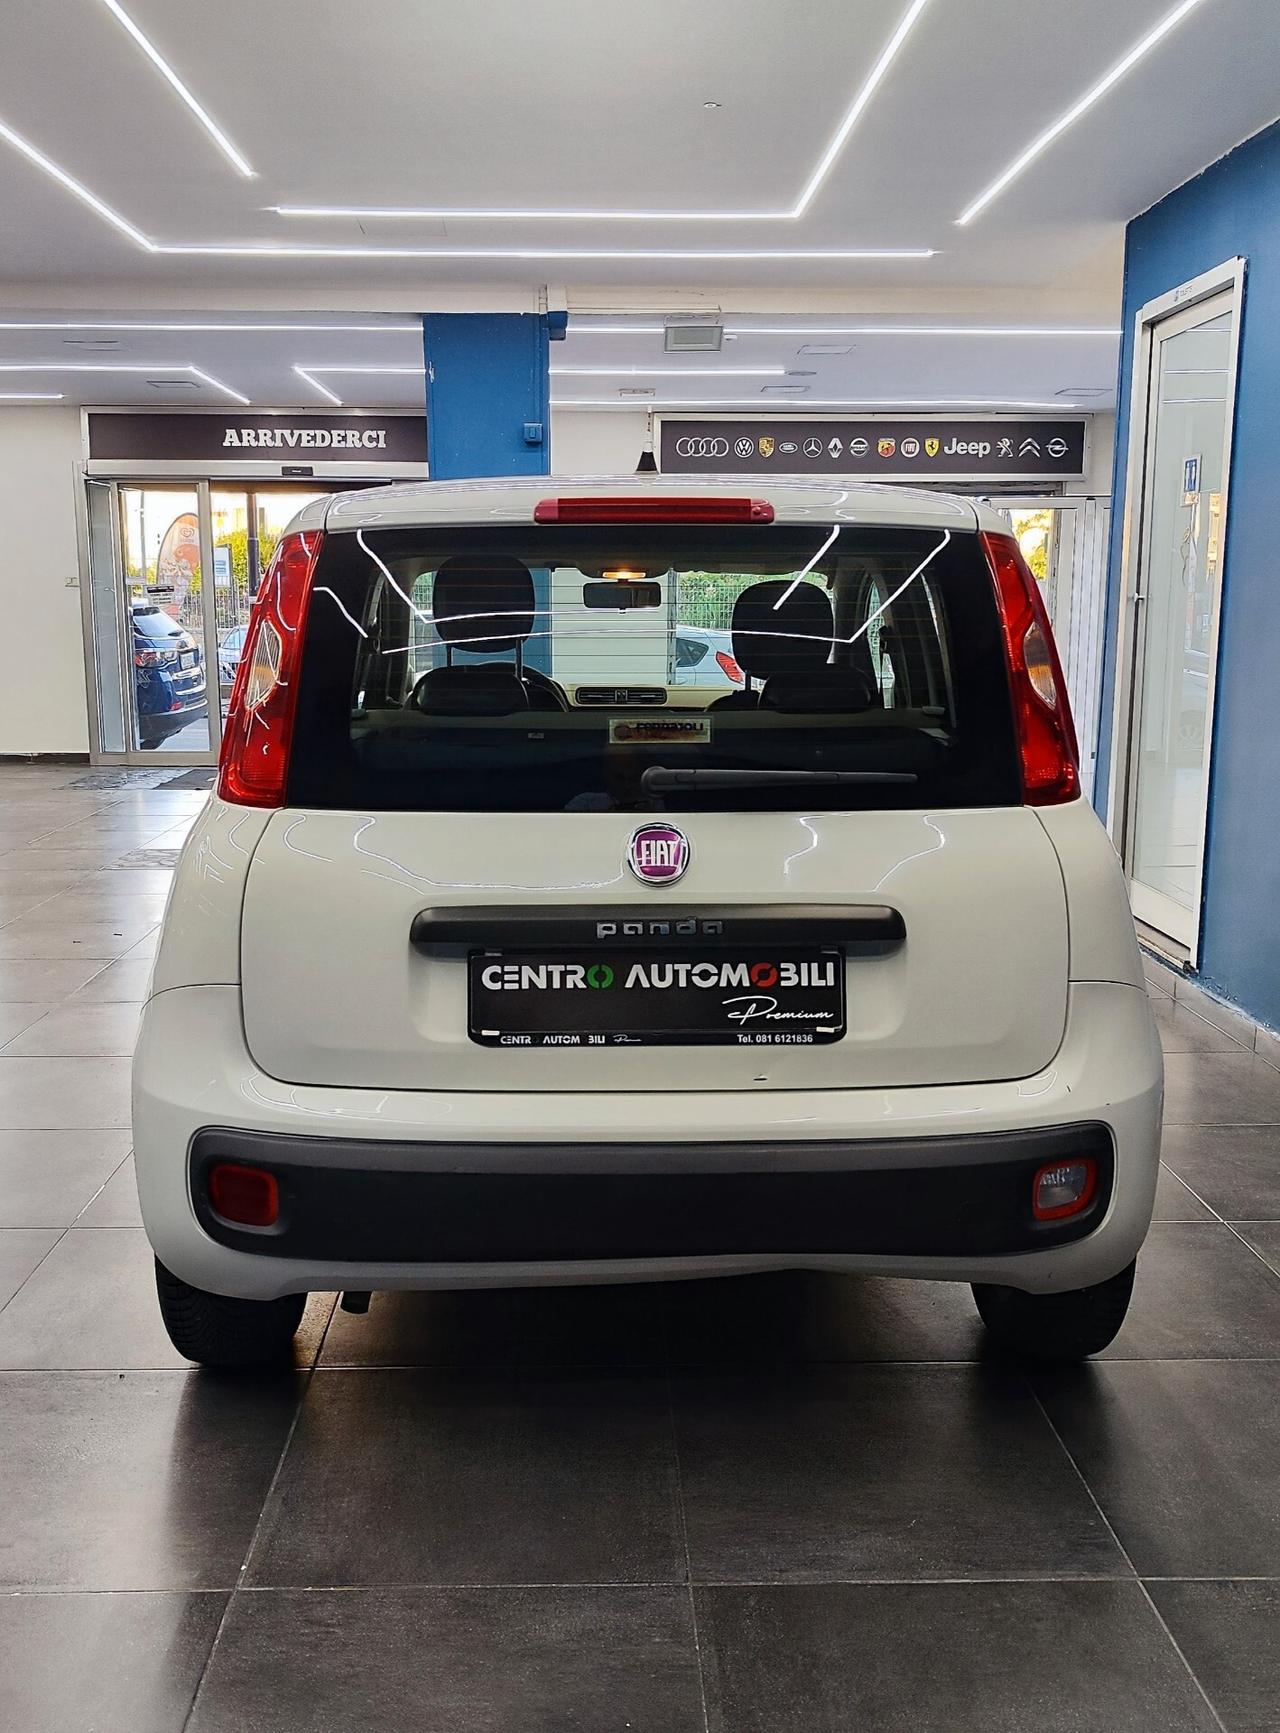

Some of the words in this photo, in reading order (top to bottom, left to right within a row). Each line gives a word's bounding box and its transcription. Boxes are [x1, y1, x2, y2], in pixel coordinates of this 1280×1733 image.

[222, 428, 387, 449] ARRIVEDERCI
[943, 437, 991, 458] Jeep
[641, 839, 679, 867] FIAT
[596, 915, 723, 939] panda
[481, 964, 614, 990] CENTRO
[625, 962, 835, 989] AUTOMOBILI
[721, 995, 835, 1025] Premium
[736, 1034, 754, 1043] Tel.
[755, 1034, 772, 1043] 081
[774, 1034, 814, 1043] 6121836
